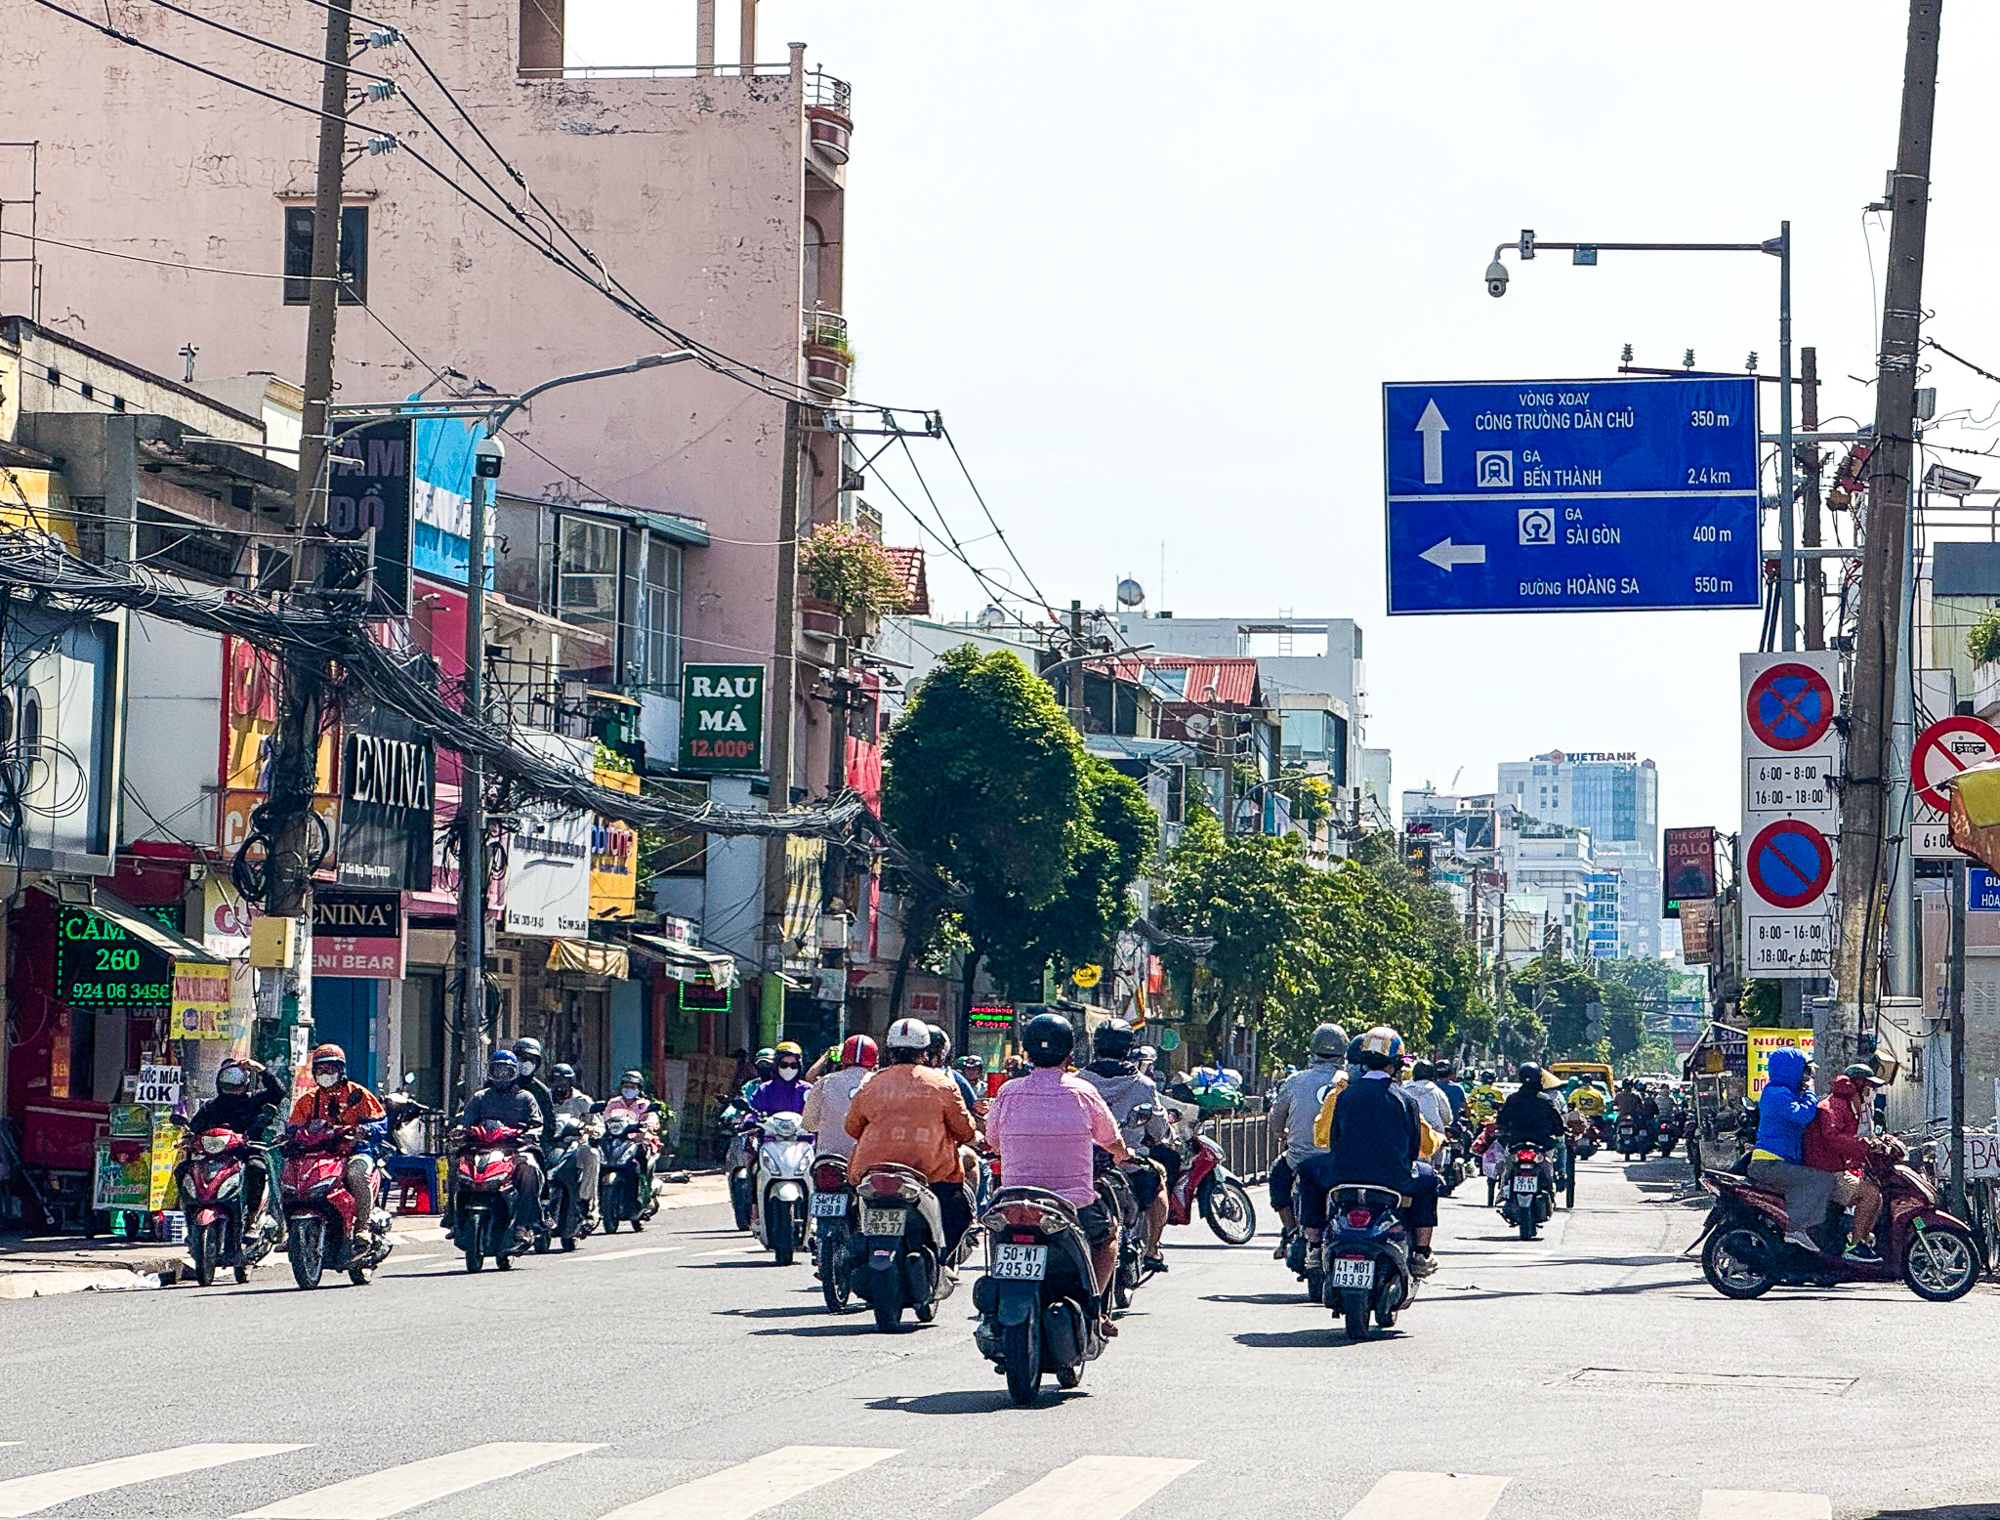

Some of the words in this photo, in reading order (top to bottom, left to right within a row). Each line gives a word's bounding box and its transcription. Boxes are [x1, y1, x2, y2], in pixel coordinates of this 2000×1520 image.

[1519, 390, 1554, 406] VÒNG
[1558, 392, 1590, 406] XOAY
[1475, 410, 1512, 431] CÔNG
[1515, 409, 1571, 430] TRƯỜNG
[1574, 408, 1603, 429] DÂN
[1606, 405, 1634, 428] CHỦ
[1691, 411, 1715, 427] 350
[1717, 414, 1730, 427] m
[1523, 450, 1541, 463] GA
[1523, 465, 1551, 487] BẾN
[1554, 465, 1602, 487] THÀNH
[1688, 468, 1708, 484] 2.4
[1710, 468, 1731, 484] km
[1565, 508, 1583, 521] GA
[1566, 524, 1589, 545] SÀI
[1591, 523, 1621, 544] GÒN
[1692, 525, 1717, 542] 400
[1719, 529, 1732, 542] m
[1519, 578, 1562, 596] ĐƯỜNG
[1566, 574, 1617, 595] HOÀNG
[1621, 577, 1640, 594] SA
[1694, 576, 1718, 593] 550
[1720, 580, 1733, 593] m
[691, 676, 757, 698] RAU
[698, 704, 747, 732] MÁ
[353, 733, 430, 810] ENINA
[1760, 766, 1782, 781] 6:00
[1794, 766, 1816, 780] 8:00
[1755, 790, 1783, 804] 16:00
[1796, 789, 1823, 803] 18:00
[1669, 842, 1711, 856] BALO
[1759, 925, 1782, 939] 8:00
[1793, 924, 1821, 939] 16:00
[95, 947, 140, 970] 260
[342, 955, 395, 970] BEAR
[73, 983, 103, 998] 924
[107, 984, 126, 998] 06
[1753, 1036, 1796, 1047] NƯỚC
[138, 1085, 173, 1101] 10K
[1003, 1246, 1038, 1262] 50-N1
[997, 1262, 1042, 1278] 295.92
